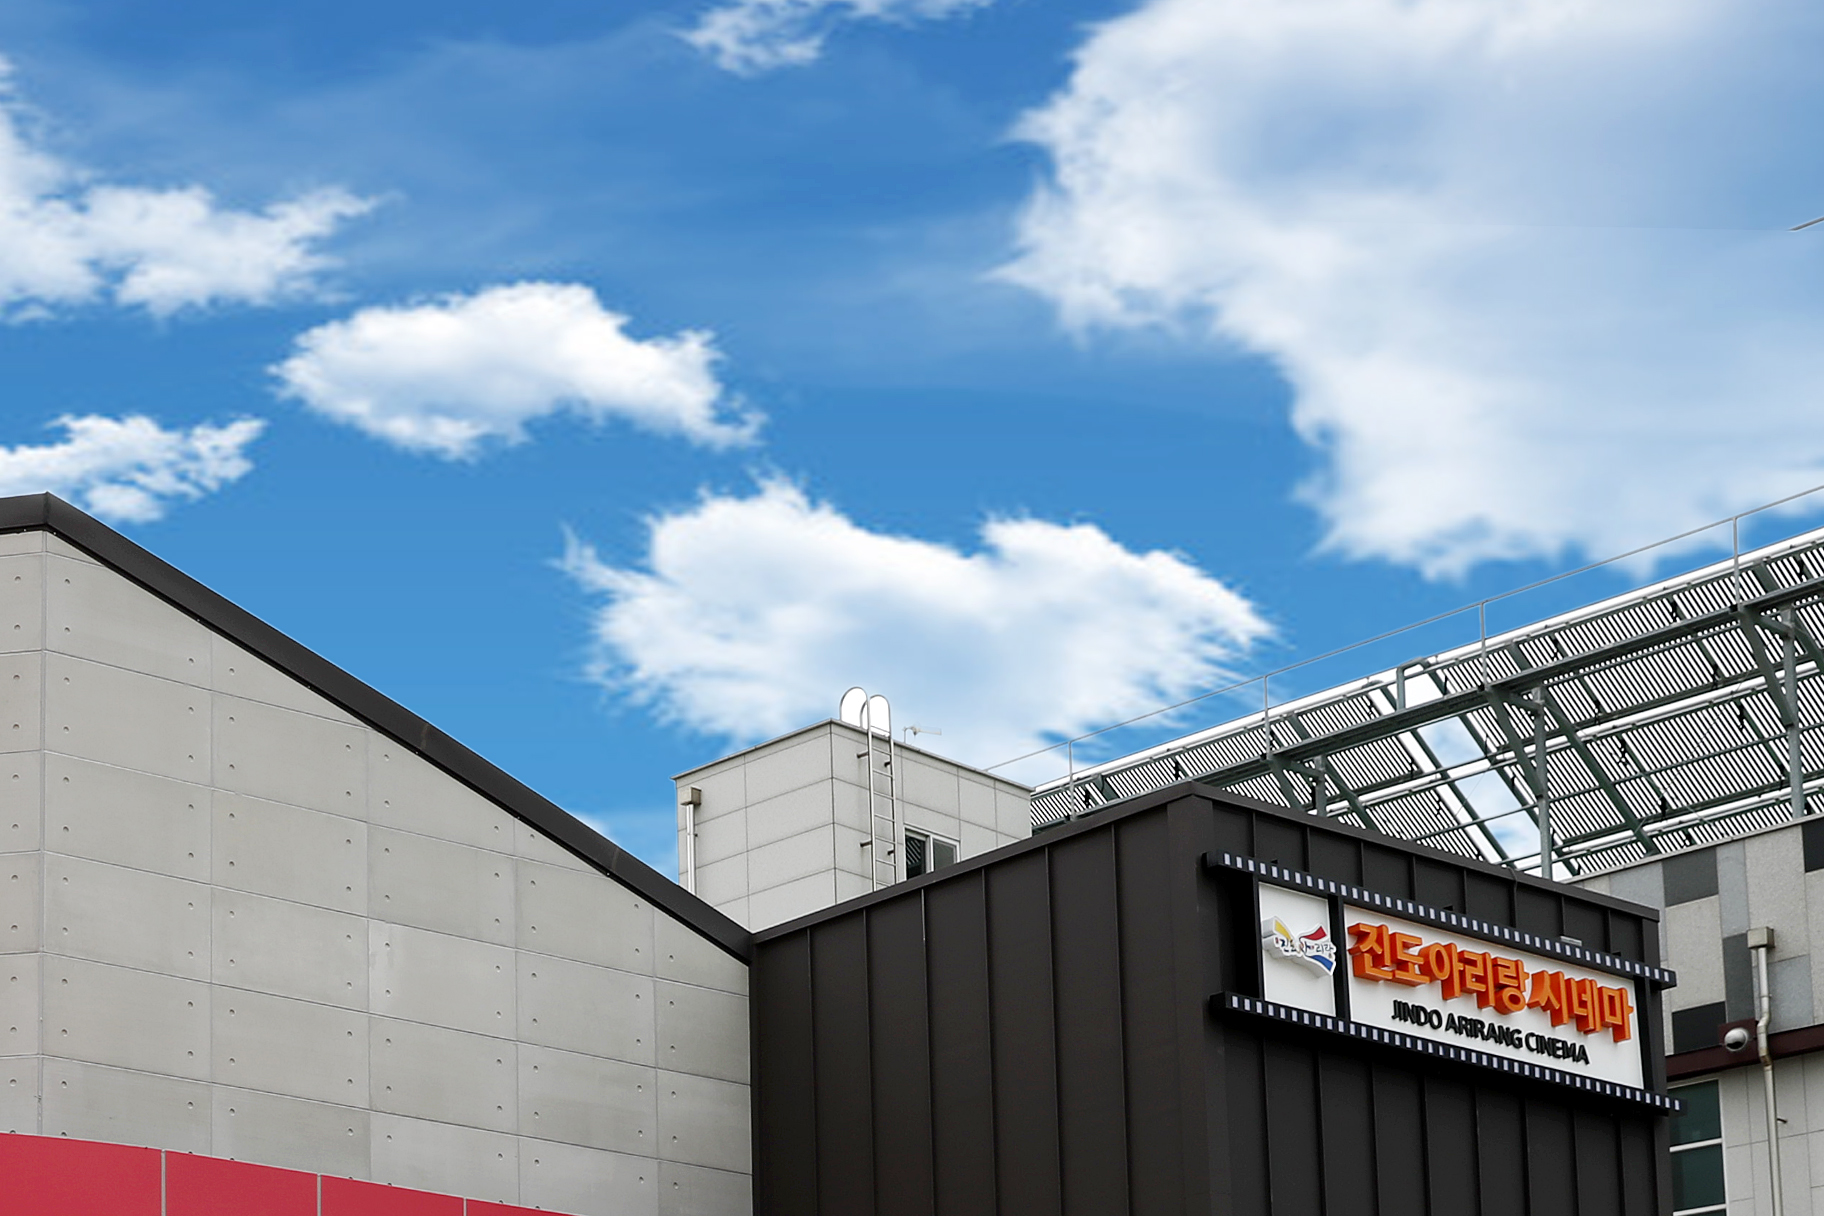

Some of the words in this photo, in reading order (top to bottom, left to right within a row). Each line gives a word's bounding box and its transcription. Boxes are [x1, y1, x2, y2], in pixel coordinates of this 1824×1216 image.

[1348, 922, 1529, 1015] 진도아리랑
[1526, 970, 1634, 1043] 시네마
[1391, 999, 1443, 1030] JINDO
[1445, 1012, 1524, 1050] ARIRANG
[1524, 1031, 1590, 1065] CINEMA
